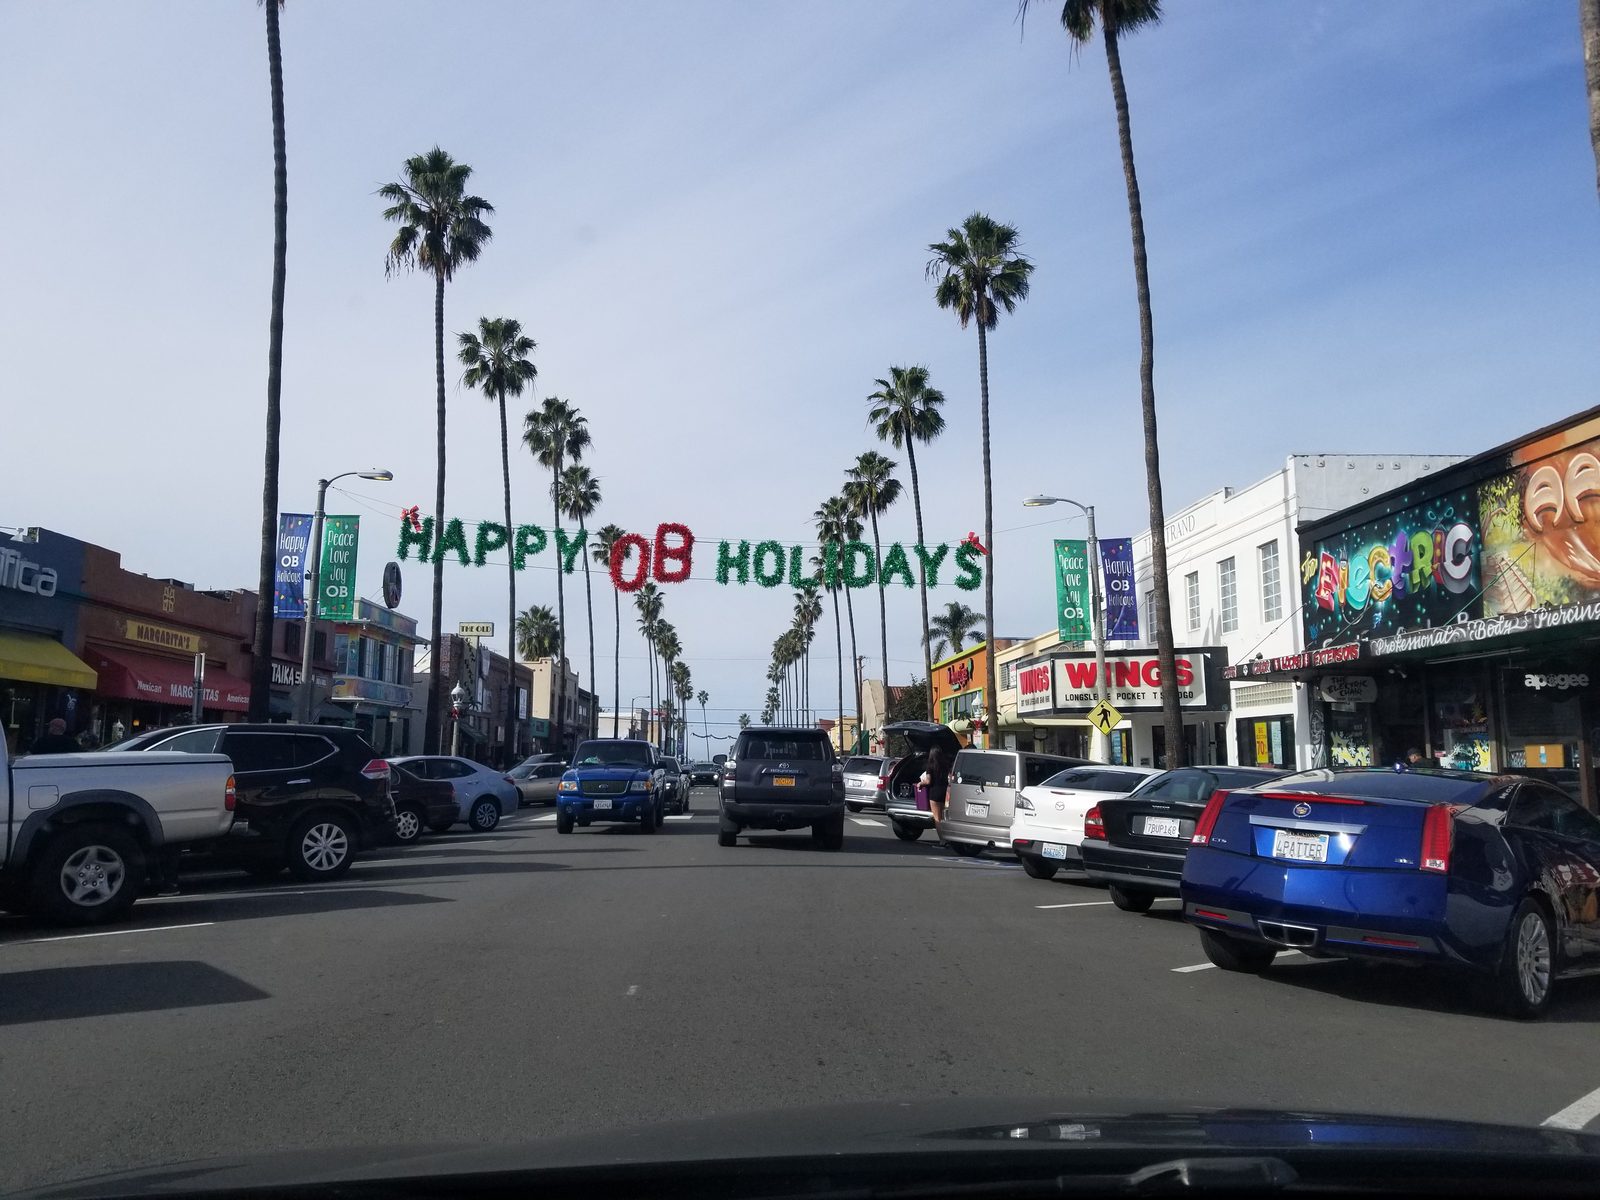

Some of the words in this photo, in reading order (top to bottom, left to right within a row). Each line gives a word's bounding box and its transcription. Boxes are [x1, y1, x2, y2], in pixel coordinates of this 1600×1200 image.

[1165, 514, 1196, 543] TRAND
[280, 533, 306, 553] Happy
[328, 530, 354, 547] Peace
[281, 556, 299, 567] OB
[330, 547, 350, 564] Love
[397, 515, 588, 575] HAPPY
[609, 522, 695, 593] OB
[716, 539, 983, 591] HOLIDAYS
[1058, 554, 1084, 570] Peace
[330, 565, 346, 584] Joy
[1105, 558, 1132, 576] Happy
[276, 570, 302, 585] Holidays
[1111, 580, 1130, 591] OB
[326, 585, 348, 597] OB
[1066, 590, 1080, 606] oy
[1064, 607, 1084, 619] OB
[136, 625, 191, 650] MARGARITA'S
[460, 625, 474, 633] THE
[475, 625, 491, 633] OLD
[1371, 624, 1463, 657] Professional
[1469, 618, 1522, 641] Body
[1530, 601, 1600, 629] Piercing
[271, 663, 294, 686] TAIKA
[1019, 665, 1050, 696] WINGS
[1064, 659, 1195, 690] WINGS
[1524, 673, 1589, 690] apogee
[137, 680, 162, 693] Mexican
[170, 683, 220, 702] MARGITAS
[1065, 691, 1111, 702] LONGSLEE
[1116, 691, 1146, 701] POCKET
[1178, 690, 1194, 699] OGO
